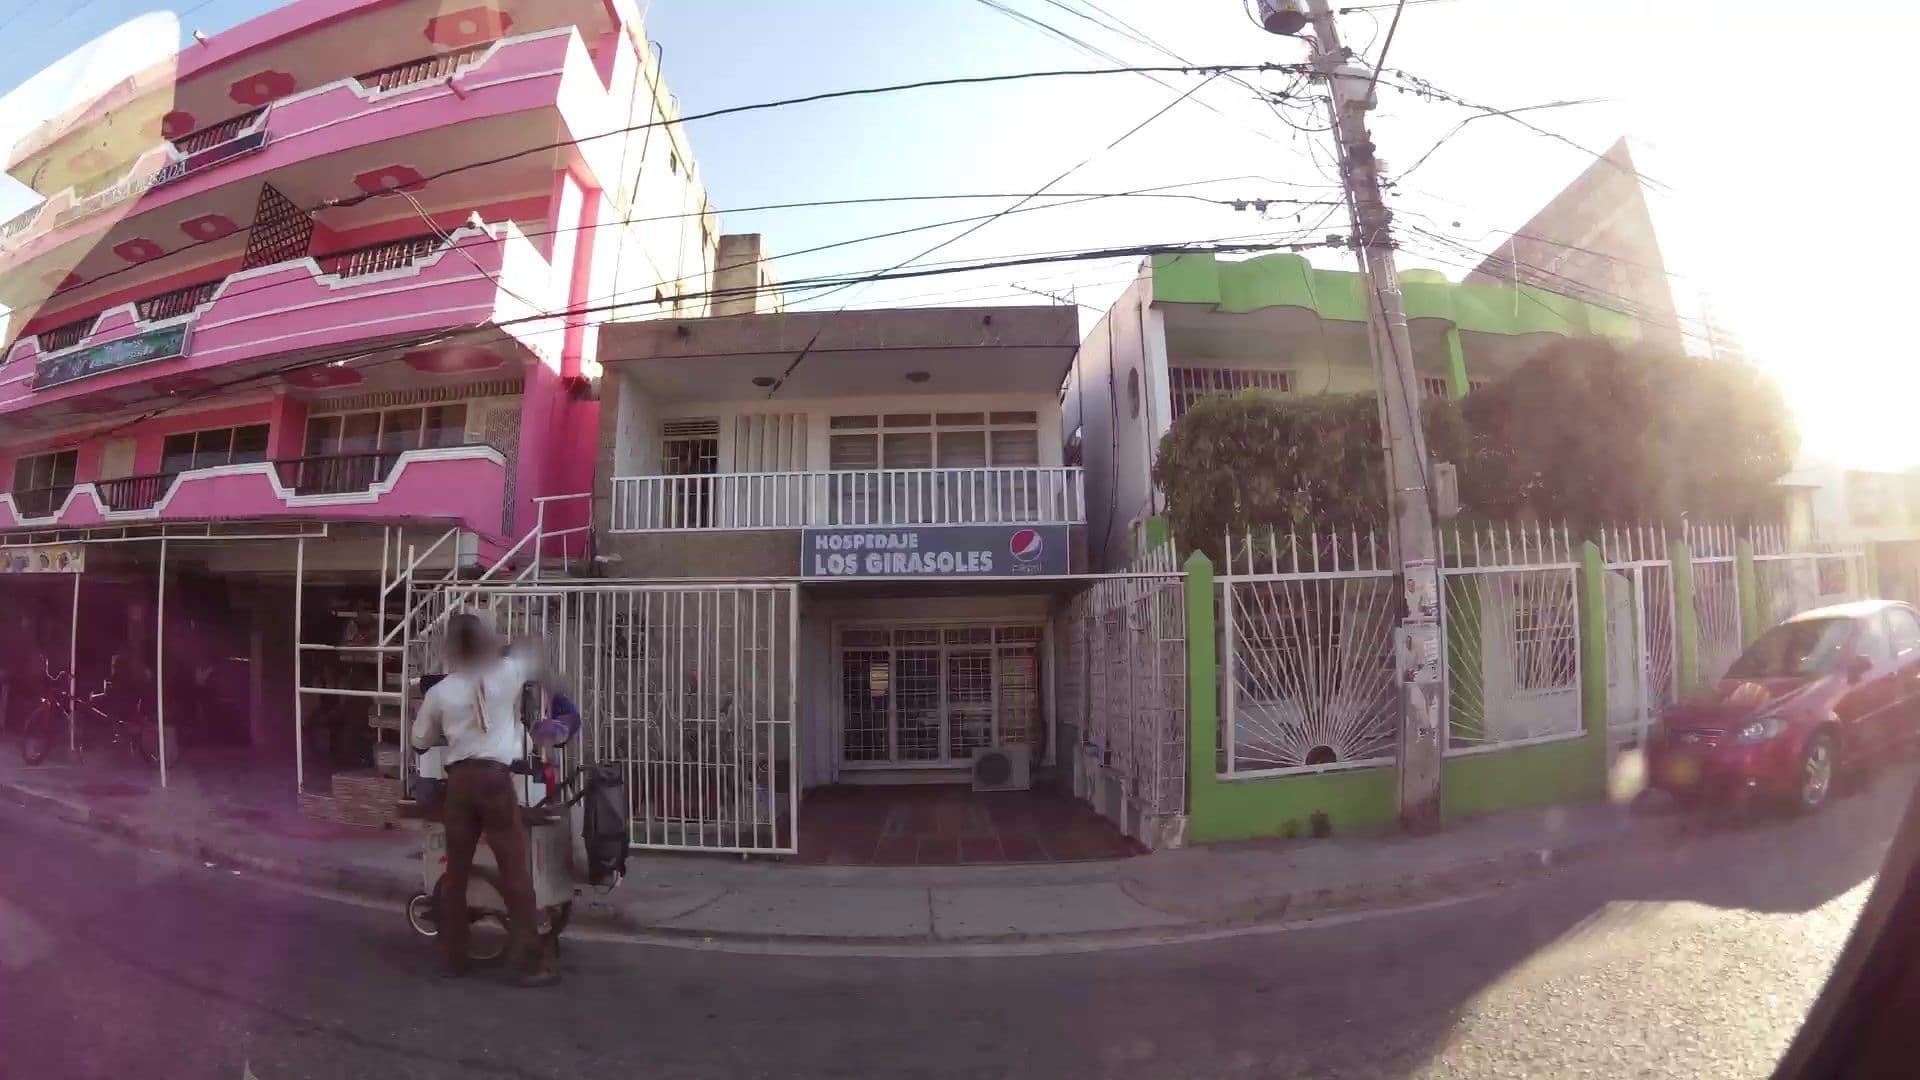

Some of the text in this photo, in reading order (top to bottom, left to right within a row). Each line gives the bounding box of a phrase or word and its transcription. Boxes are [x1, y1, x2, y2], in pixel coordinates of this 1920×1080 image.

[815, 533, 919, 550] HOSPEDAJE
[815, 553, 858, 575] LOS
[865, 551, 993, 574] GIRASOLES
